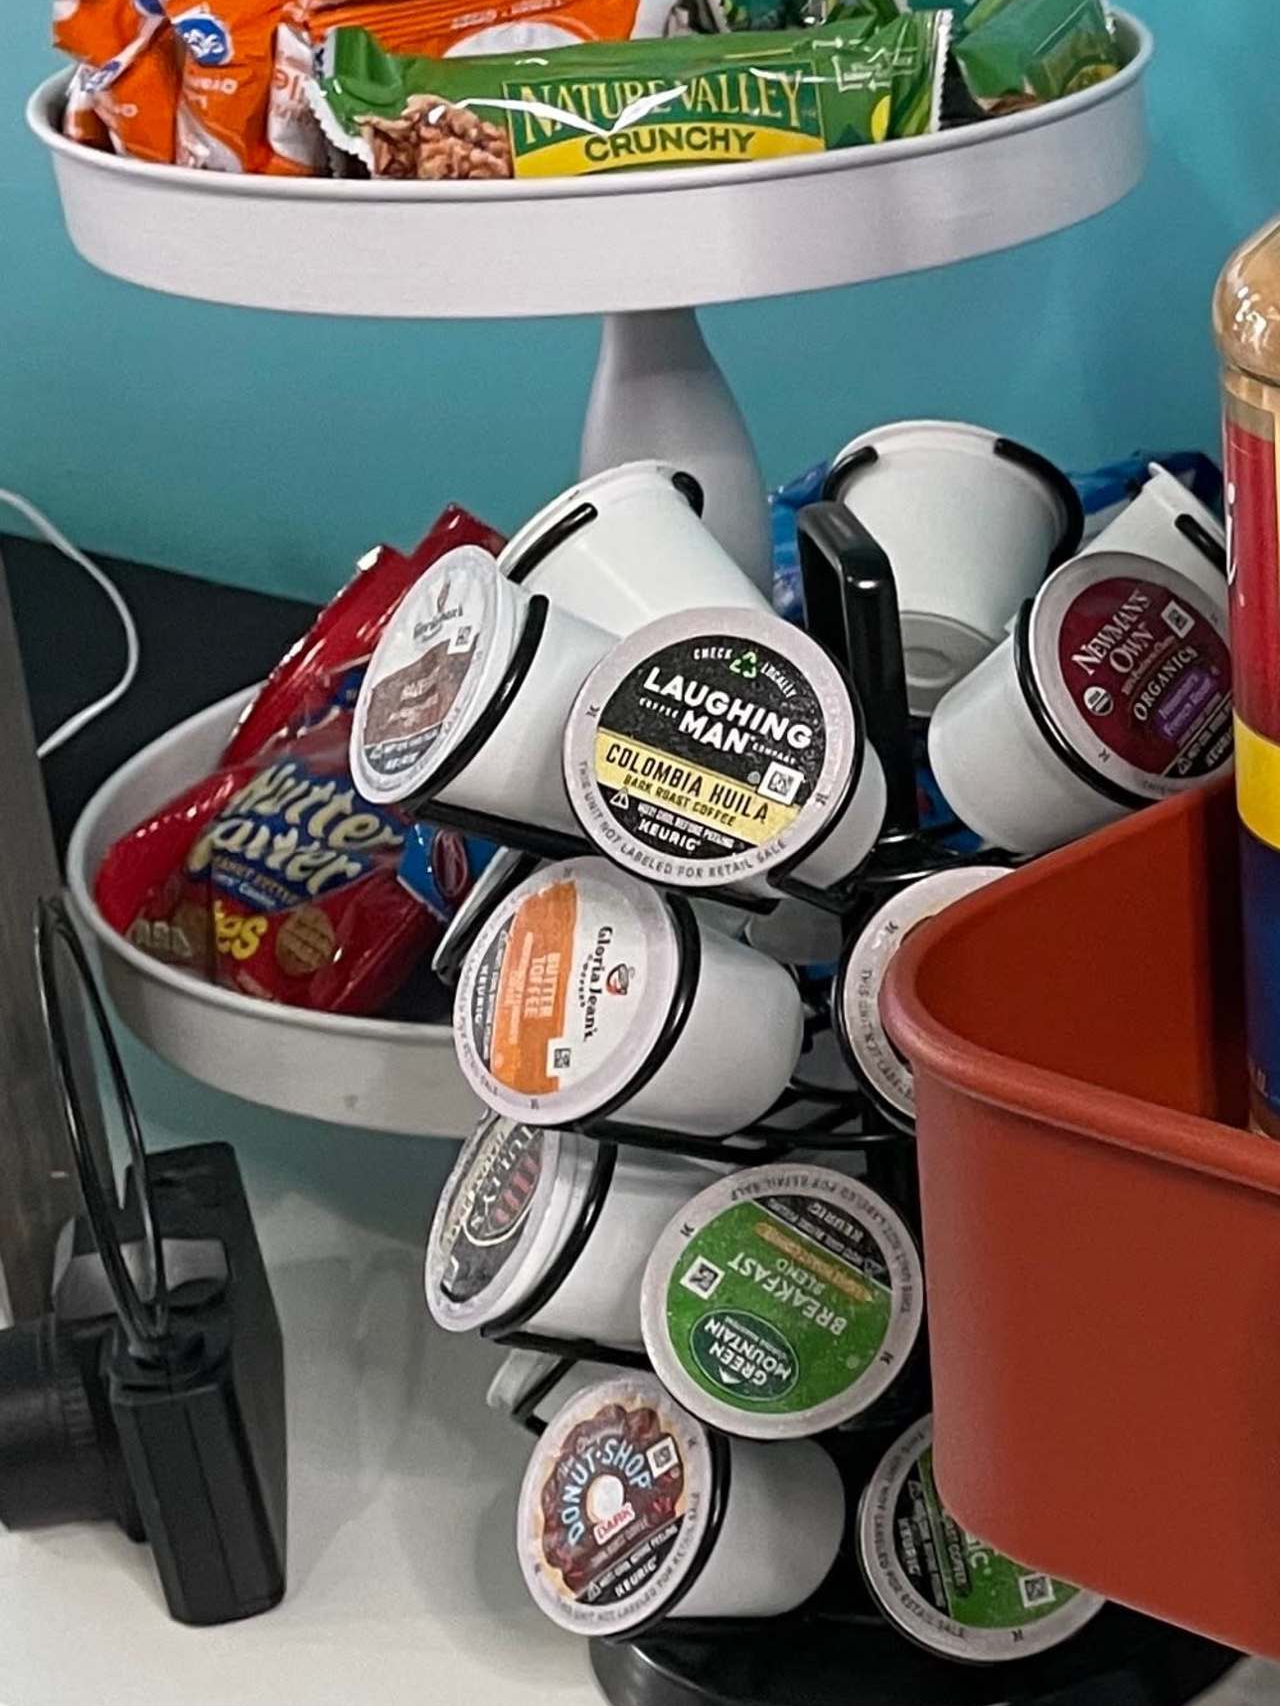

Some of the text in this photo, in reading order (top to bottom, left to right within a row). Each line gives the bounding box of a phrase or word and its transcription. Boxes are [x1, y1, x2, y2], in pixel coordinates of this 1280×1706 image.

[684, 68, 804, 127] VALLEY
[584, 125, 756, 163] CRUNCHY
[643, 667, 814, 750] LAUGHING
[1133, 646, 1200, 722] ORGANICS
[678, 710, 750, 755] MAN
[605, 743, 769, 825] COLOMBIA HUILA
[637, 818, 698, 851] KEURIG
[591, 925, 614, 989] Gloria
[727, 1252, 848, 1336] BREAKFAST
[776, 1258, 827, 1296] BLEND
[703, 1317, 792, 1381] MOUNTAIN
[708, 1343, 768, 1387] GREEN
